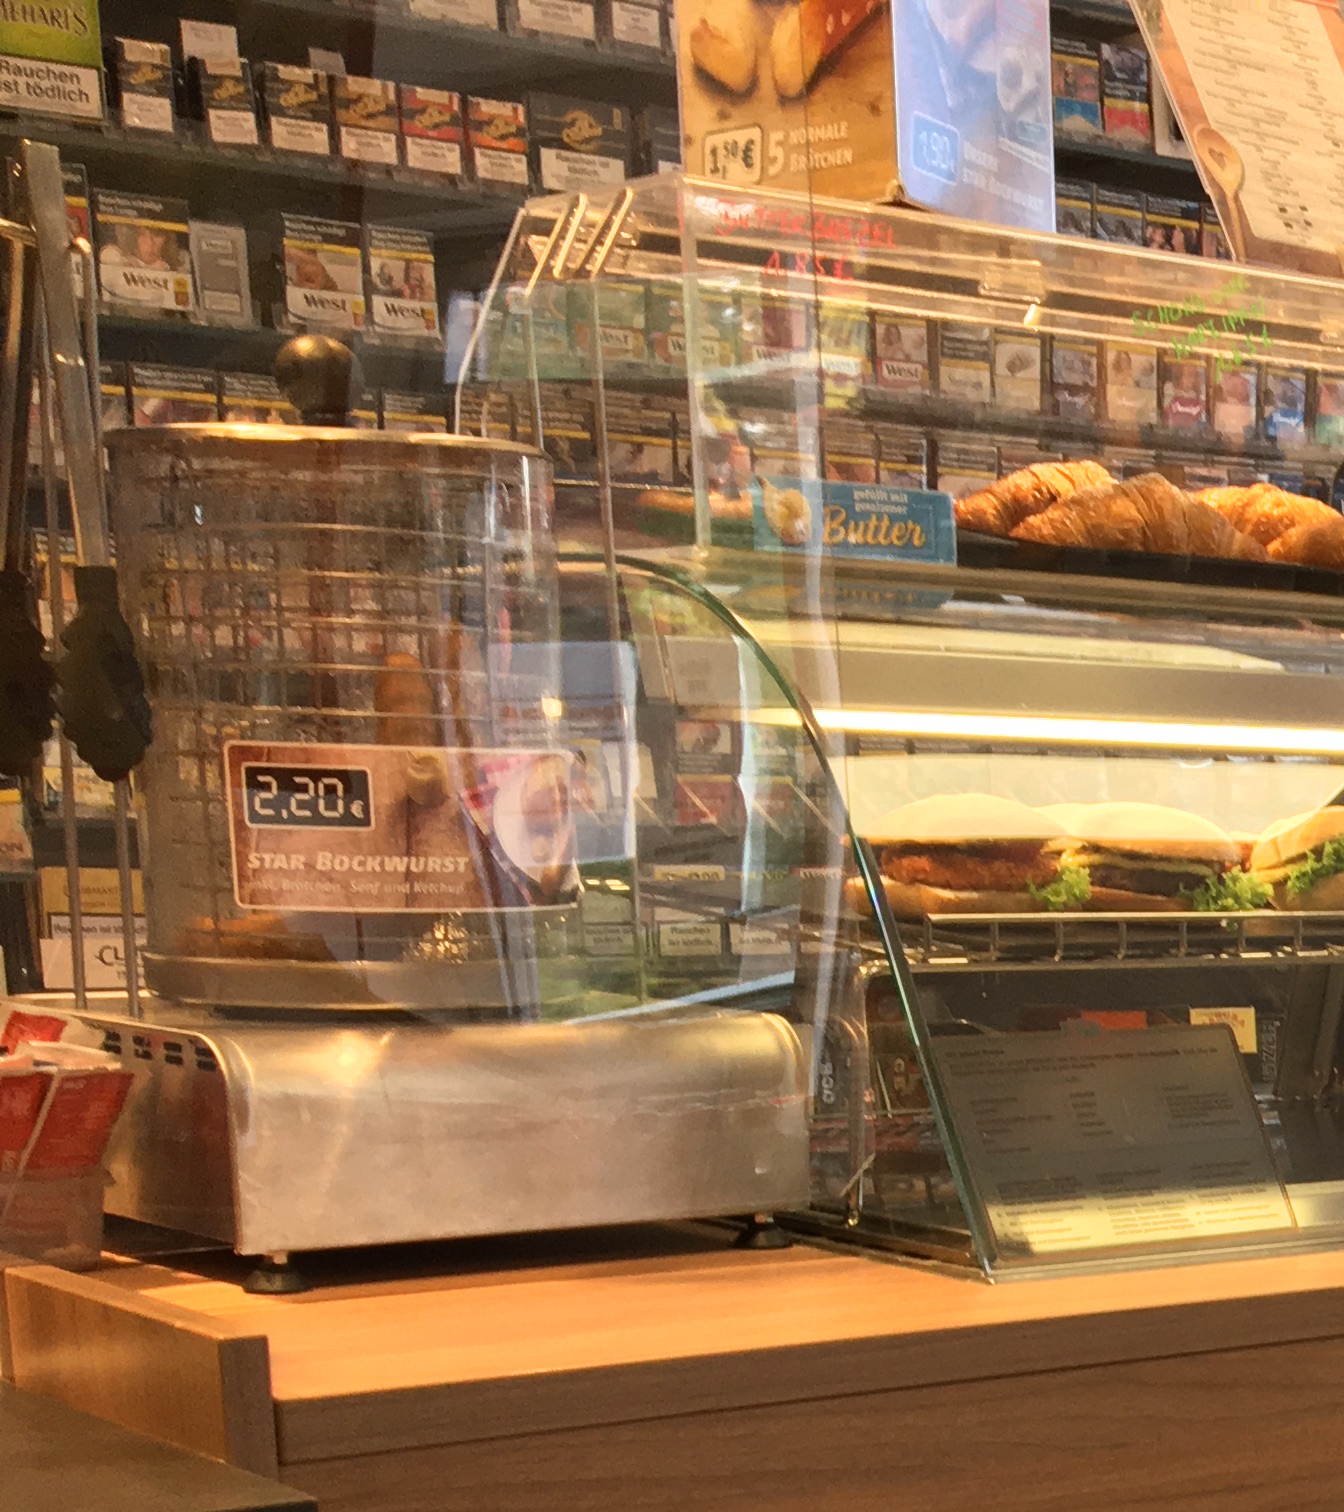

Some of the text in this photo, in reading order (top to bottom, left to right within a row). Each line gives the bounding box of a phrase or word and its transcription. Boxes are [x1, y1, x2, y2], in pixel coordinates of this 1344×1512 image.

[26, 80, 92, 104] tödlich
[788, 121, 850, 146] NORMALE
[767, 130, 786, 178] 5
[789, 148, 854, 174] BRÖTCHEN
[122, 271, 170, 292] West
[303, 292, 348, 314] West
[384, 301, 428, 320] West
[885, 362, 920, 380] West
[822, 505, 928, 548] Butter
[246, 851, 470, 874] STAR BOCKWURST
